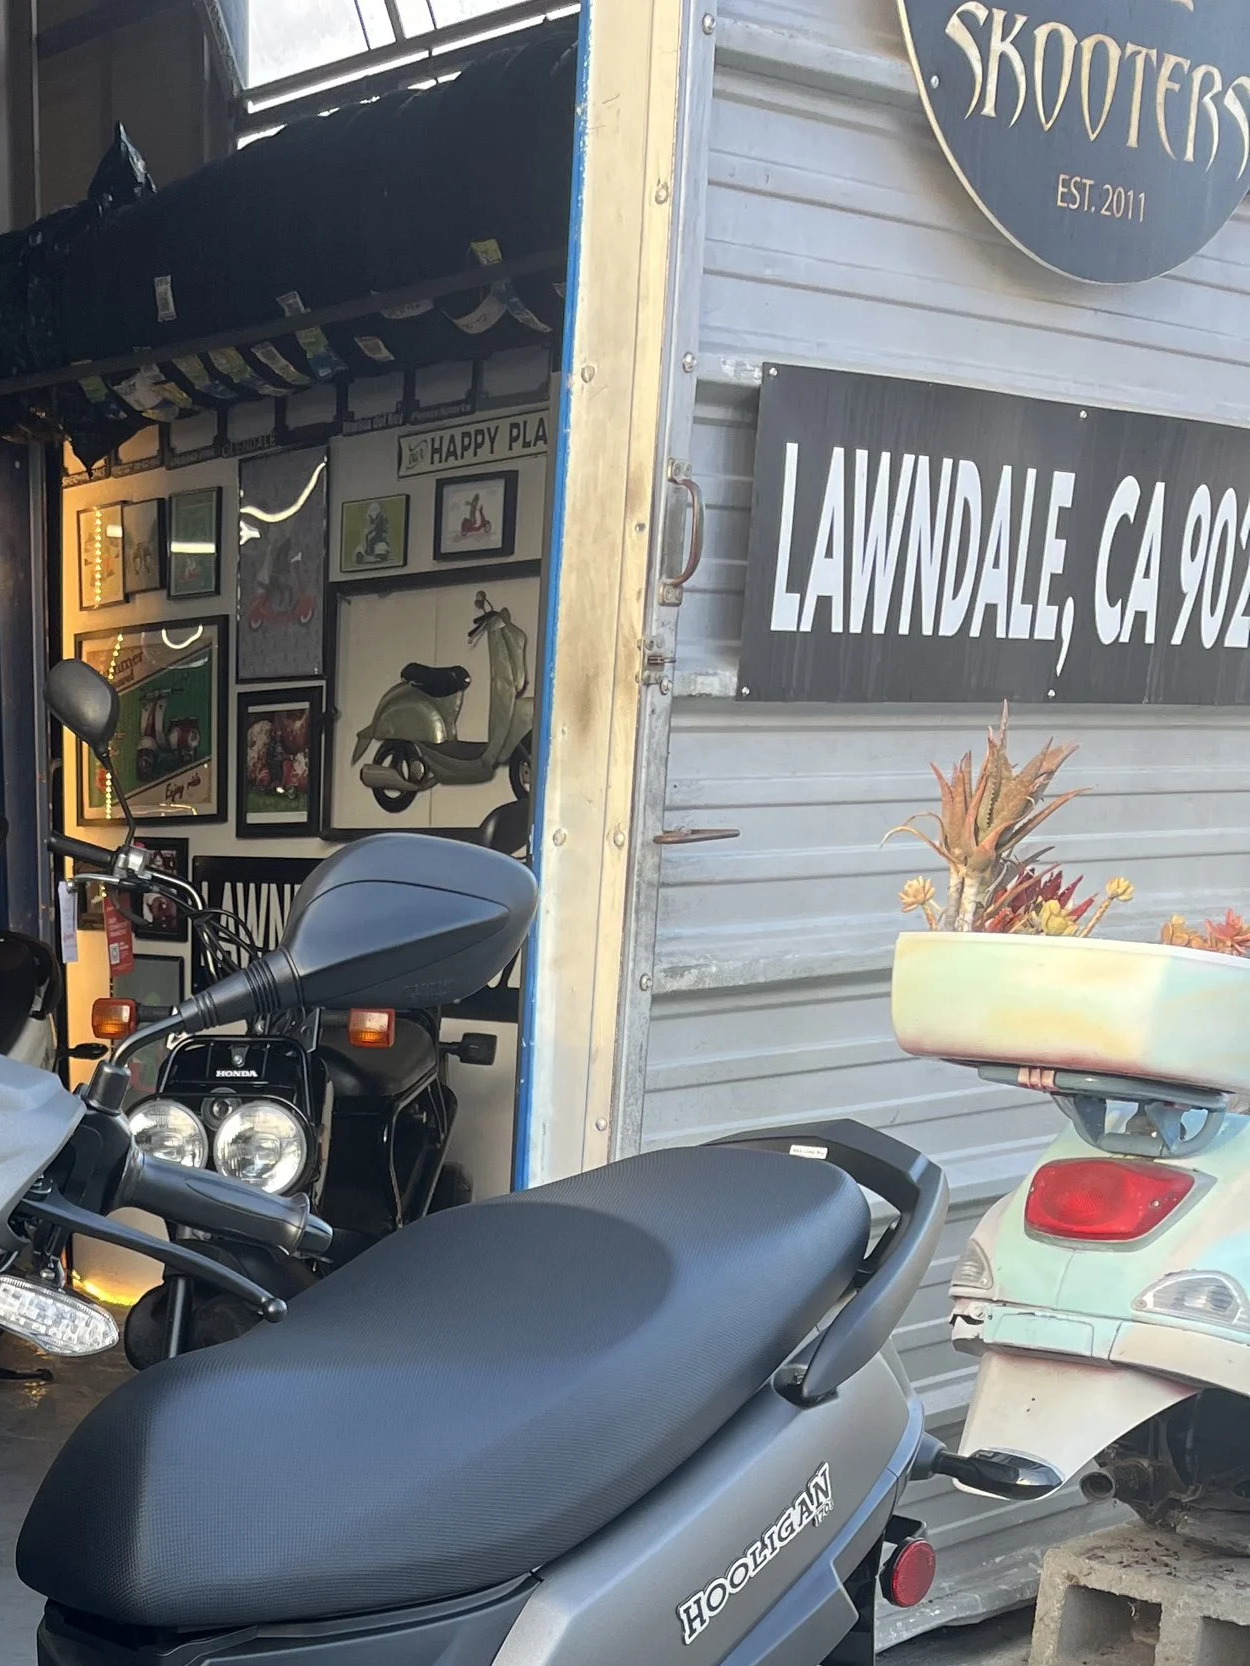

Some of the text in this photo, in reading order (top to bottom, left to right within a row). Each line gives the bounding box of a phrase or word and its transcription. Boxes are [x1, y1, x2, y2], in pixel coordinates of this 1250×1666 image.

[945, 0, 1250, 181] SKOOTERS
[1056, 173, 1147, 223] EST. 2011
[430, 425, 499, 465] HAPPY
[770, 442, 1076, 677] LAWNDALE,
[1095, 475, 1165, 645] CA
[215, 1069, 258, 1078] HONDA
[678, 1462, 832, 1645] HOOLIGAN
